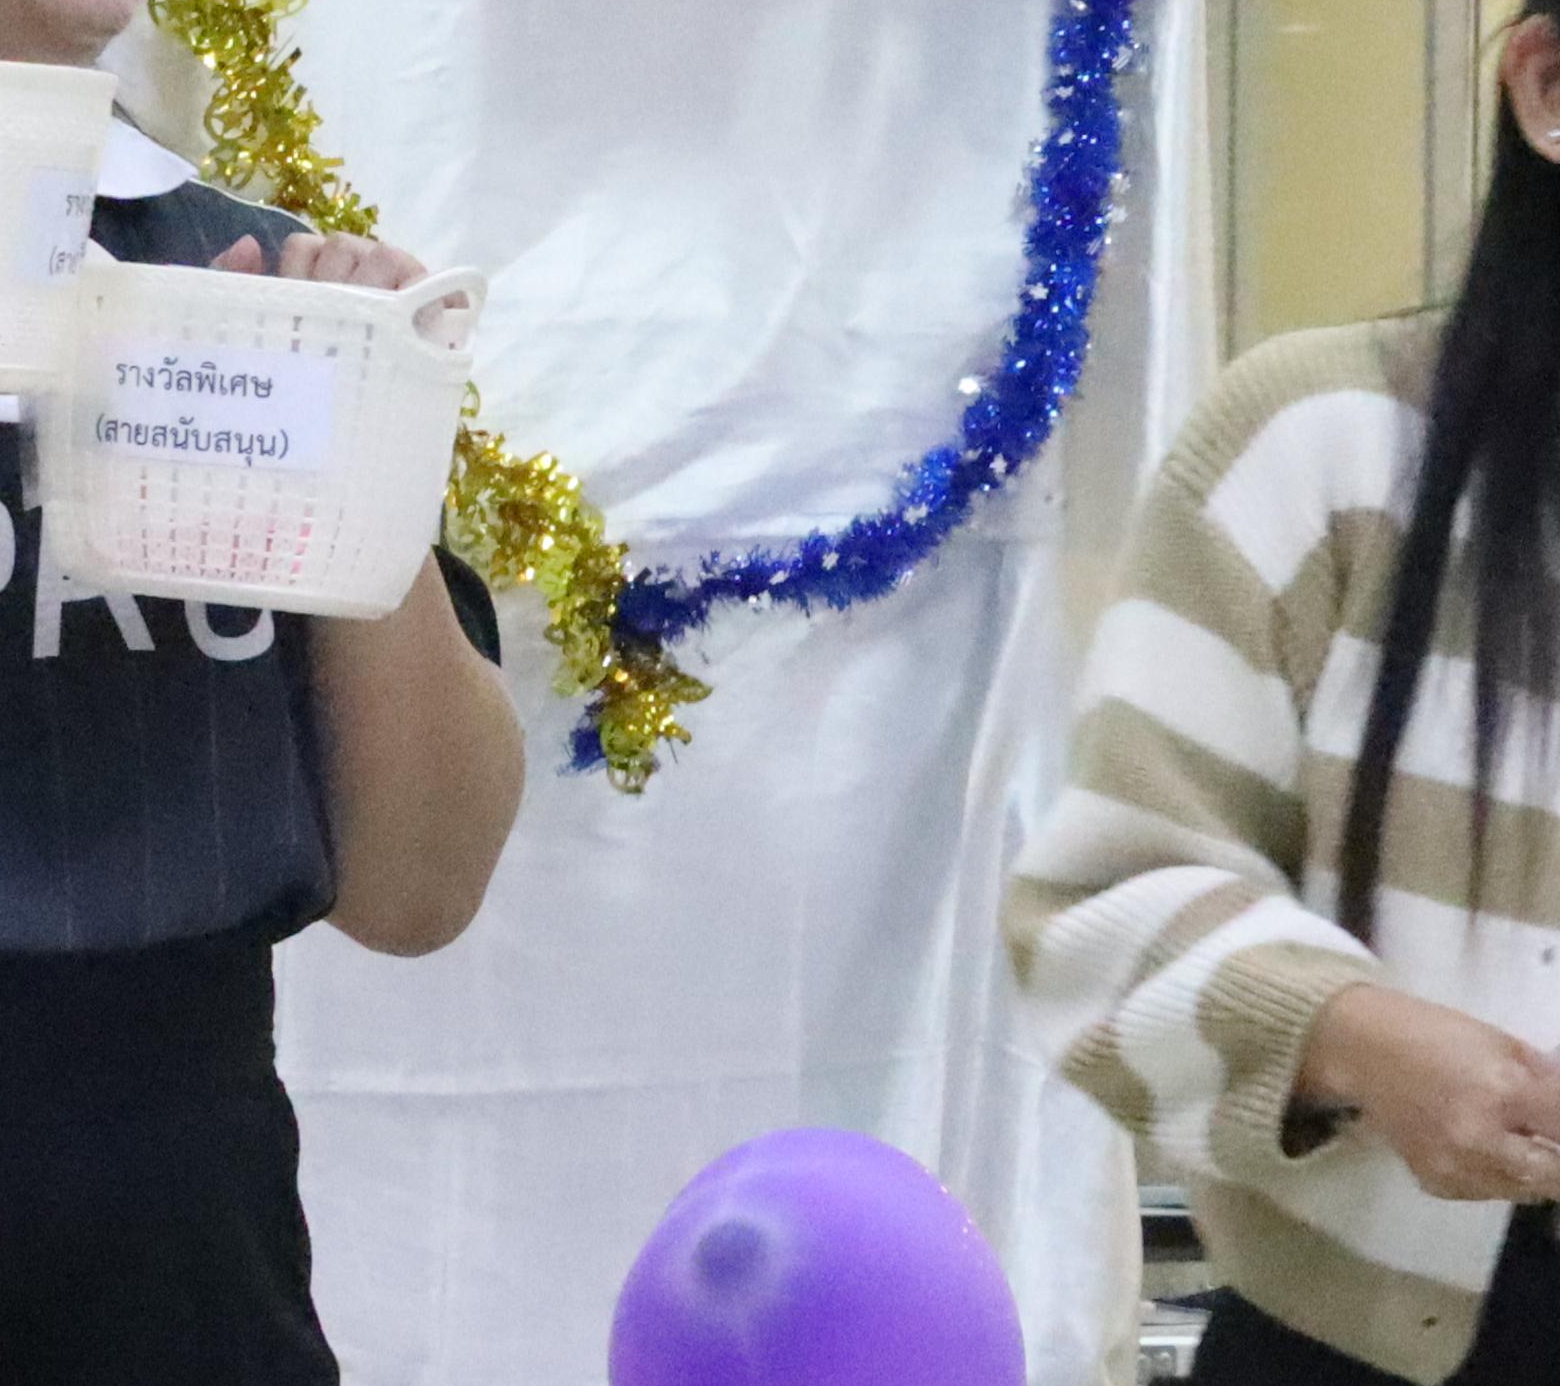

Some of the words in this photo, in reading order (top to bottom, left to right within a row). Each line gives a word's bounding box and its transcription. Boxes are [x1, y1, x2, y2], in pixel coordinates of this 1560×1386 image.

[116, 356, 273, 399] รางวัลพิเศษ
[96, 413, 289, 467] (สายสนับสนุน)
